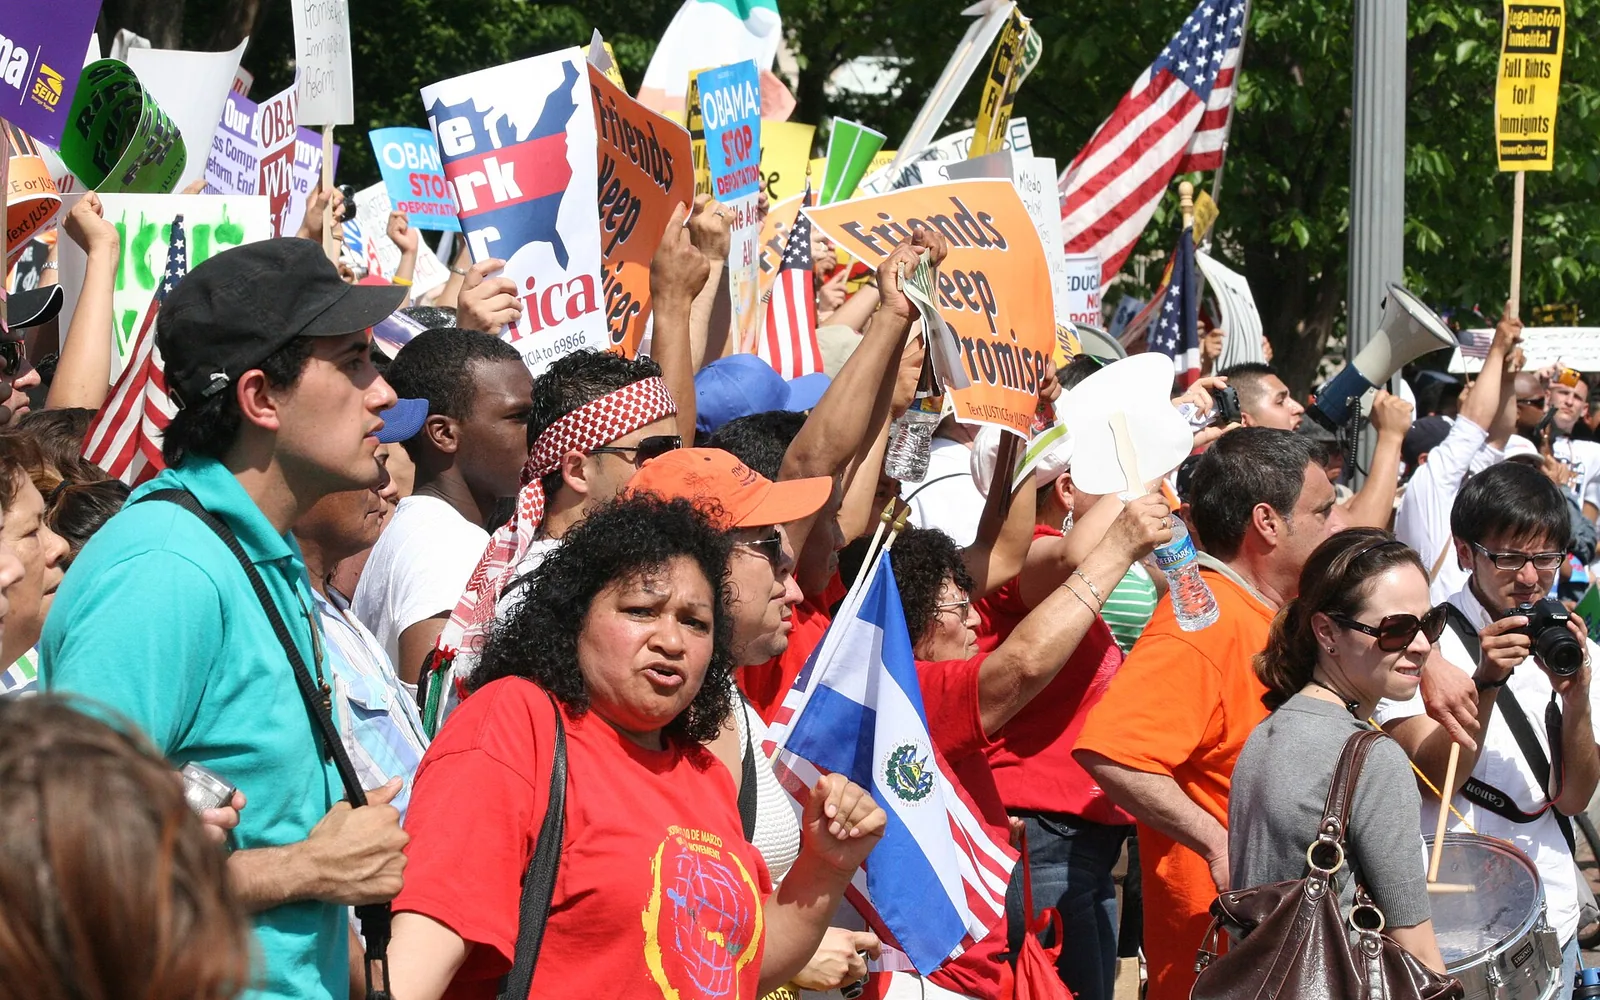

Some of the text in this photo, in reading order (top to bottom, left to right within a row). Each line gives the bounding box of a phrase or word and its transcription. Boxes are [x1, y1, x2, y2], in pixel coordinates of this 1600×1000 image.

[1504, 57, 1521, 78] Full
[32, 82, 60, 106] SEIU
[703, 80, 761, 131] OBAMA:
[1512, 84, 1527, 105] for
[224, 98, 250, 136] Our
[591, 83, 674, 195] Friends
[721, 124, 753, 168] STOP
[24, 178, 37, 190] or
[236, 171, 256, 196] End
[936, 268, 998, 334] eep
[542, 347, 553, 361] to
[553, 330, 586, 355] 69866
[966, 402, 983, 417] Text
[982, 404, 1010, 422] JUSTICE
[1173, 546, 1190, 561] PARK
[1465, 782, 1505, 808] Canon
[690, 829, 700, 841] DE
[700, 830, 723, 848] MARZO
